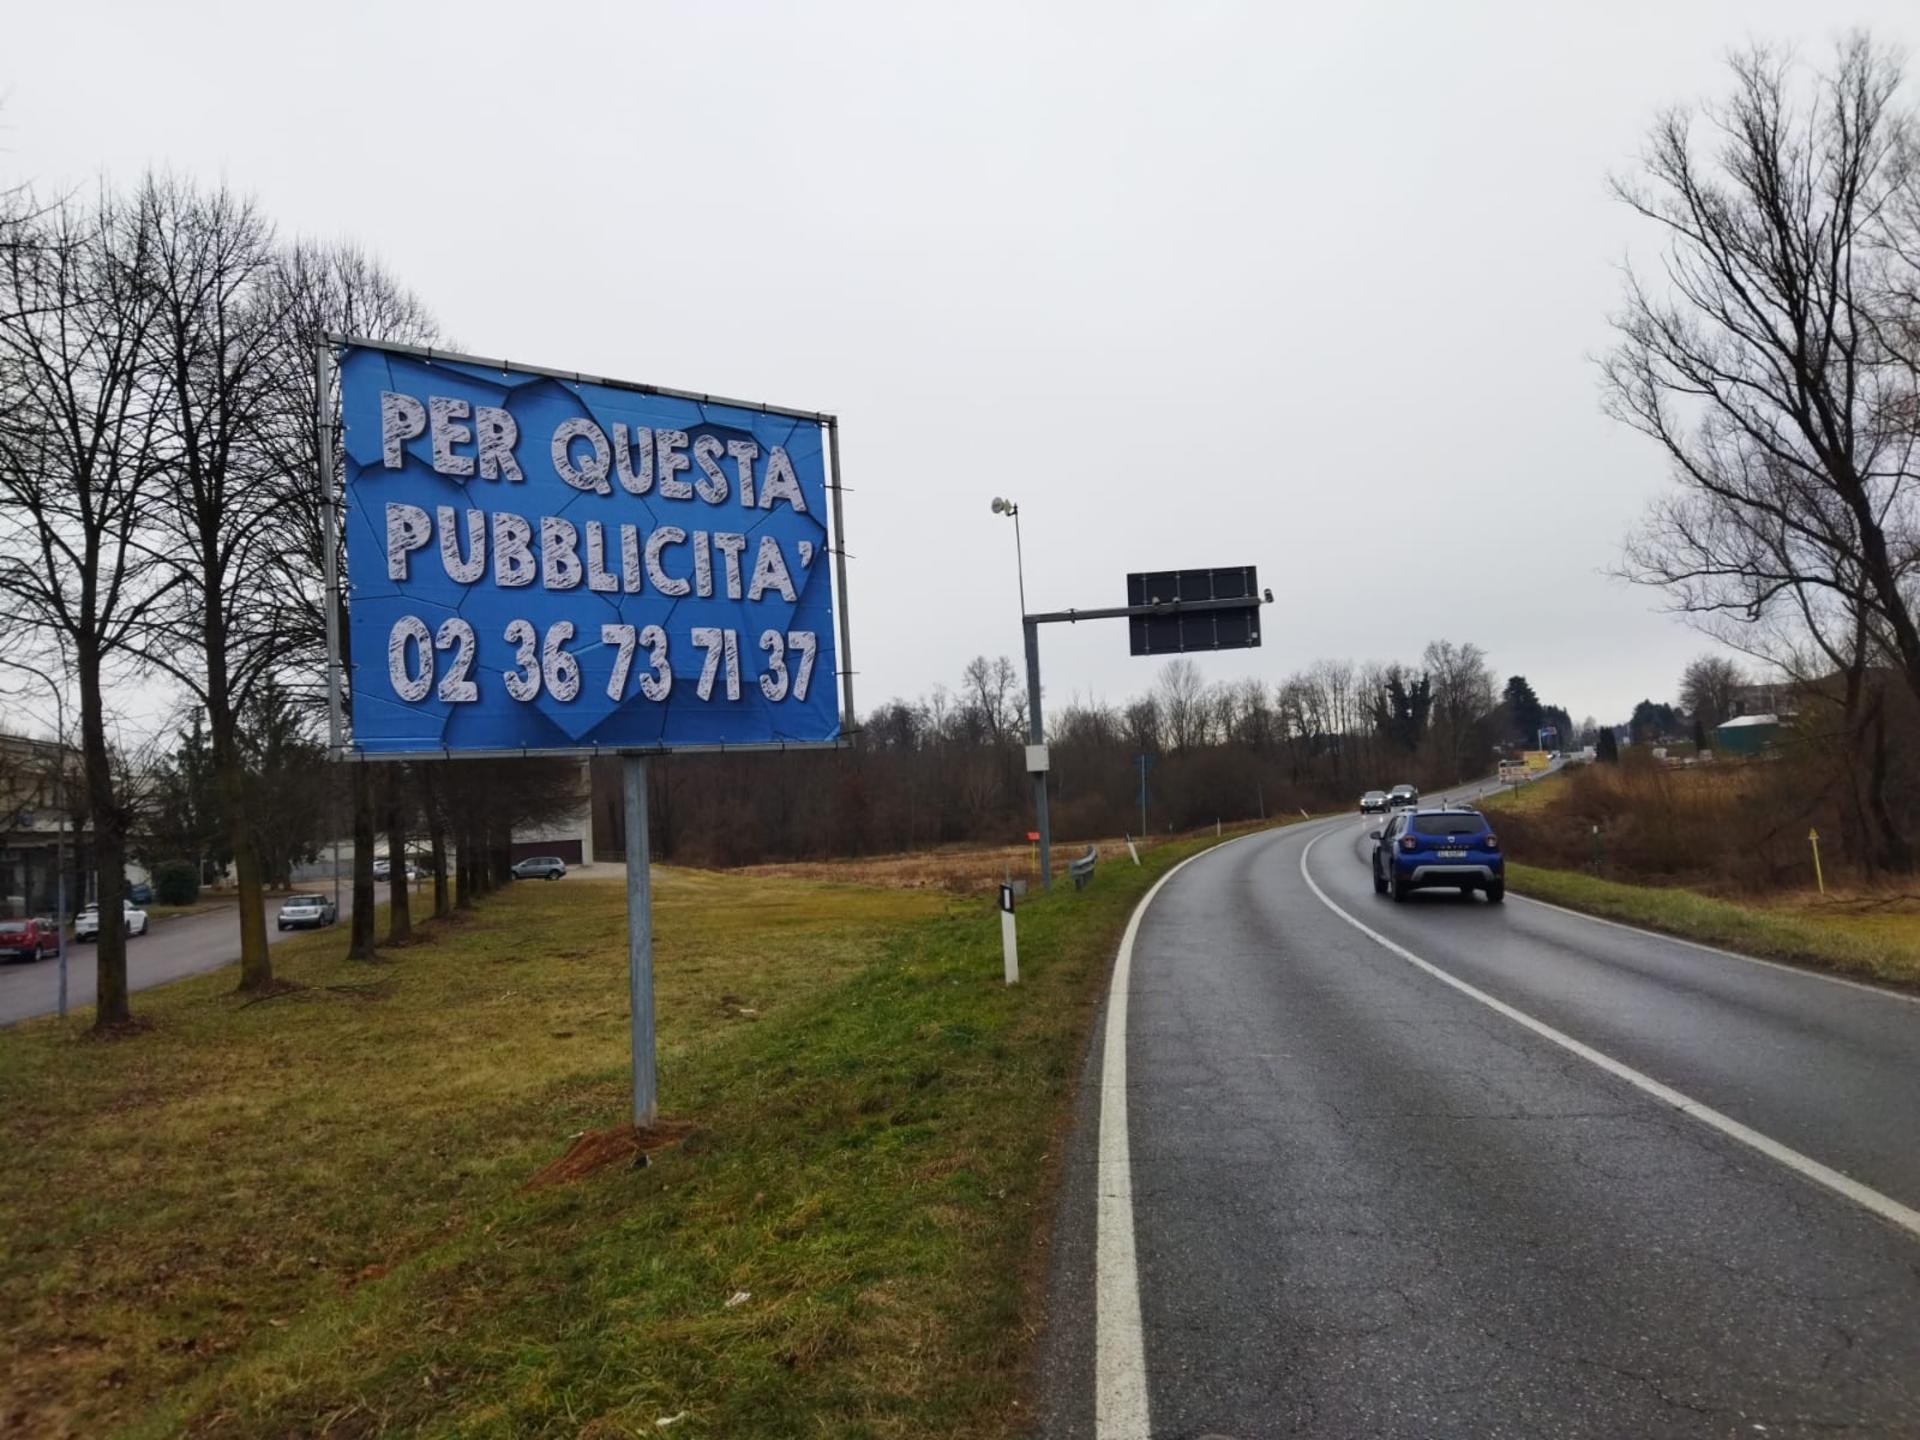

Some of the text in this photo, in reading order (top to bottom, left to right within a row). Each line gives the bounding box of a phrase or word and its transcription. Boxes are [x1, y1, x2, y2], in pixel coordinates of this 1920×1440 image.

[381, 390, 807, 512] PER QUESTA
[388, 615, 816, 702] 02 36 73 71 37
